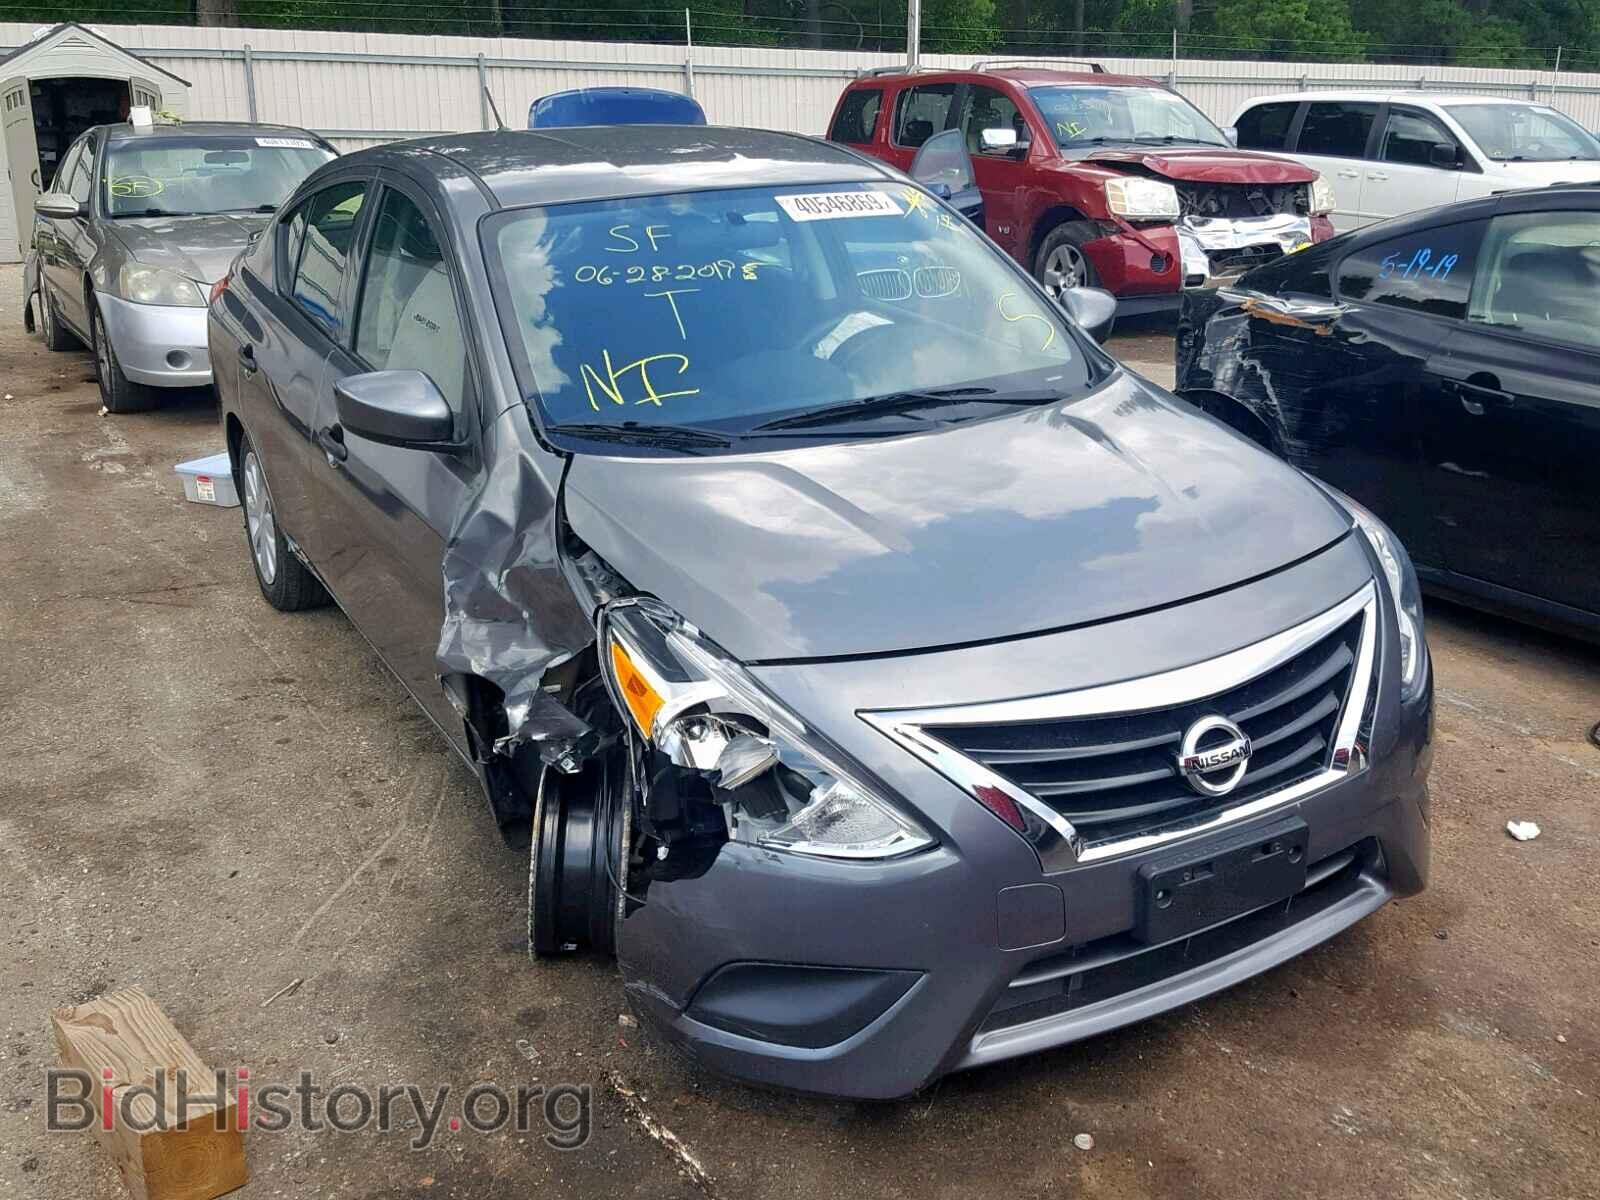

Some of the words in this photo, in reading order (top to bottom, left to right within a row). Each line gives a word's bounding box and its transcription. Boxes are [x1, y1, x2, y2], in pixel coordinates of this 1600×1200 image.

[604, 224, 672, 252] SF
[643, 288, 701, 340] T
[1190, 739, 1252, 771] NISSAN
